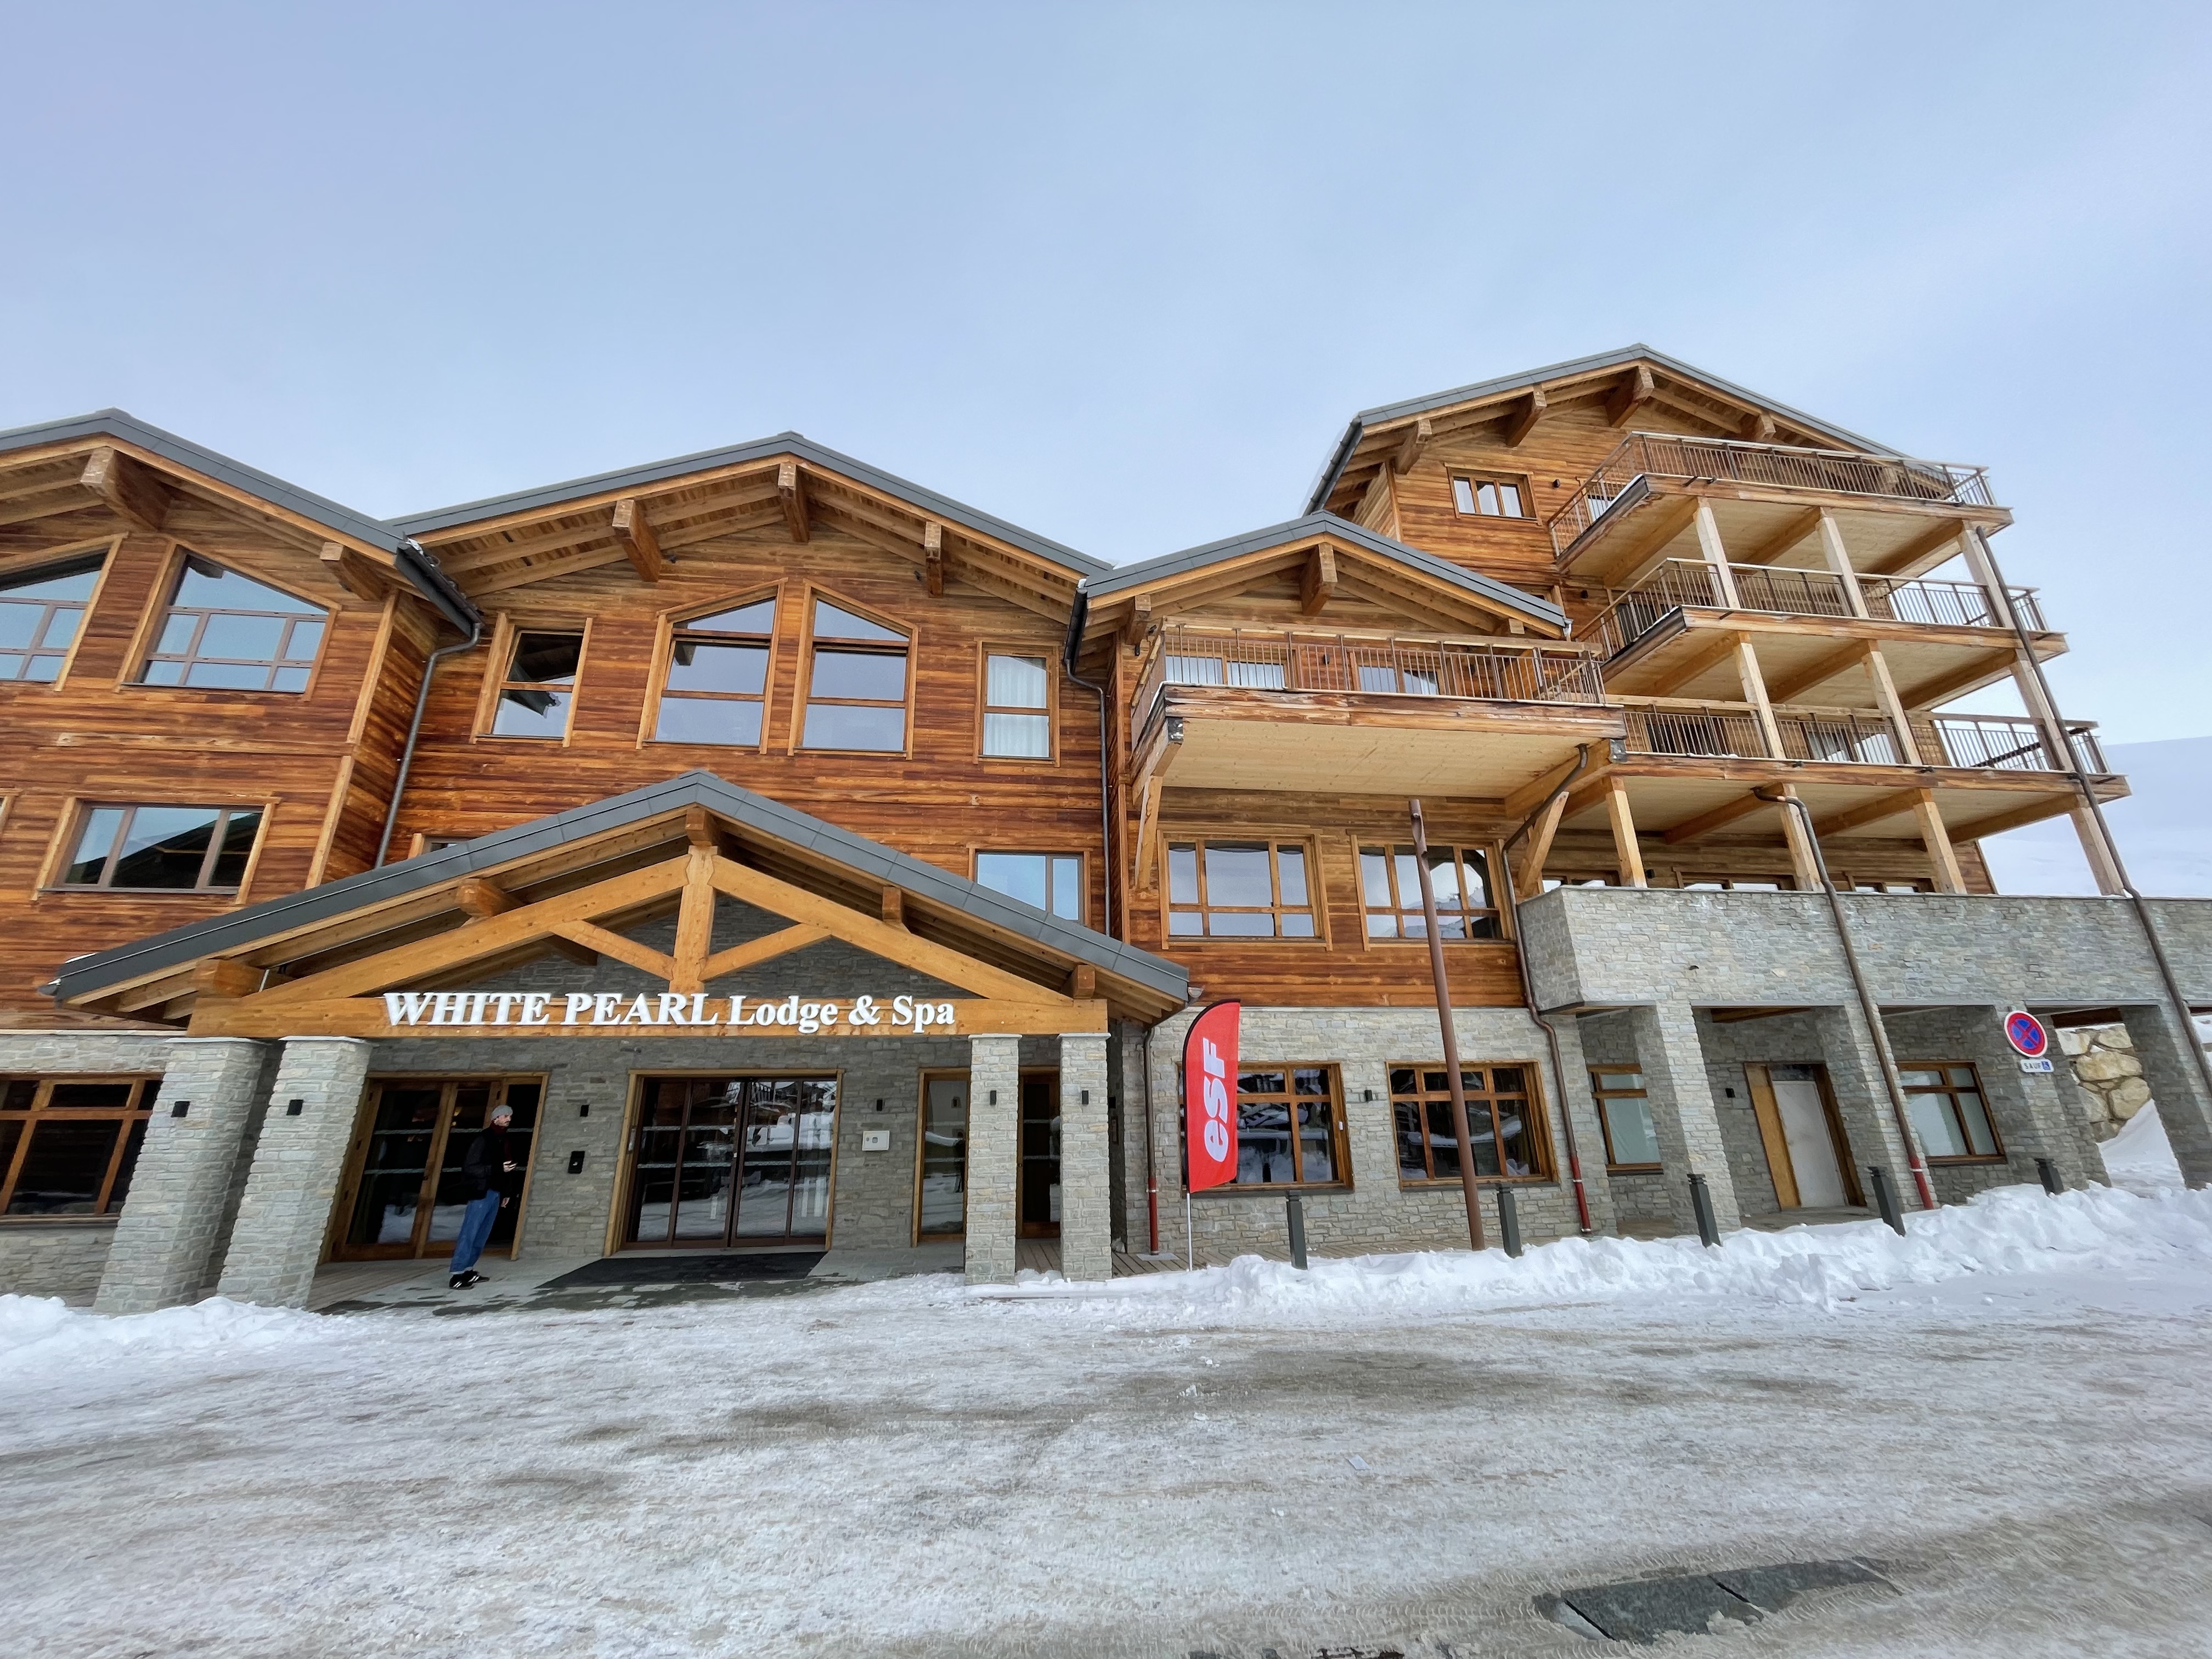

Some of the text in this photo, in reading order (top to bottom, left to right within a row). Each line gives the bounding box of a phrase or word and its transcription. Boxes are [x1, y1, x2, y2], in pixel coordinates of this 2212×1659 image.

[383, 992, 956, 1034] WHITE PEARL Lodge & Spa
